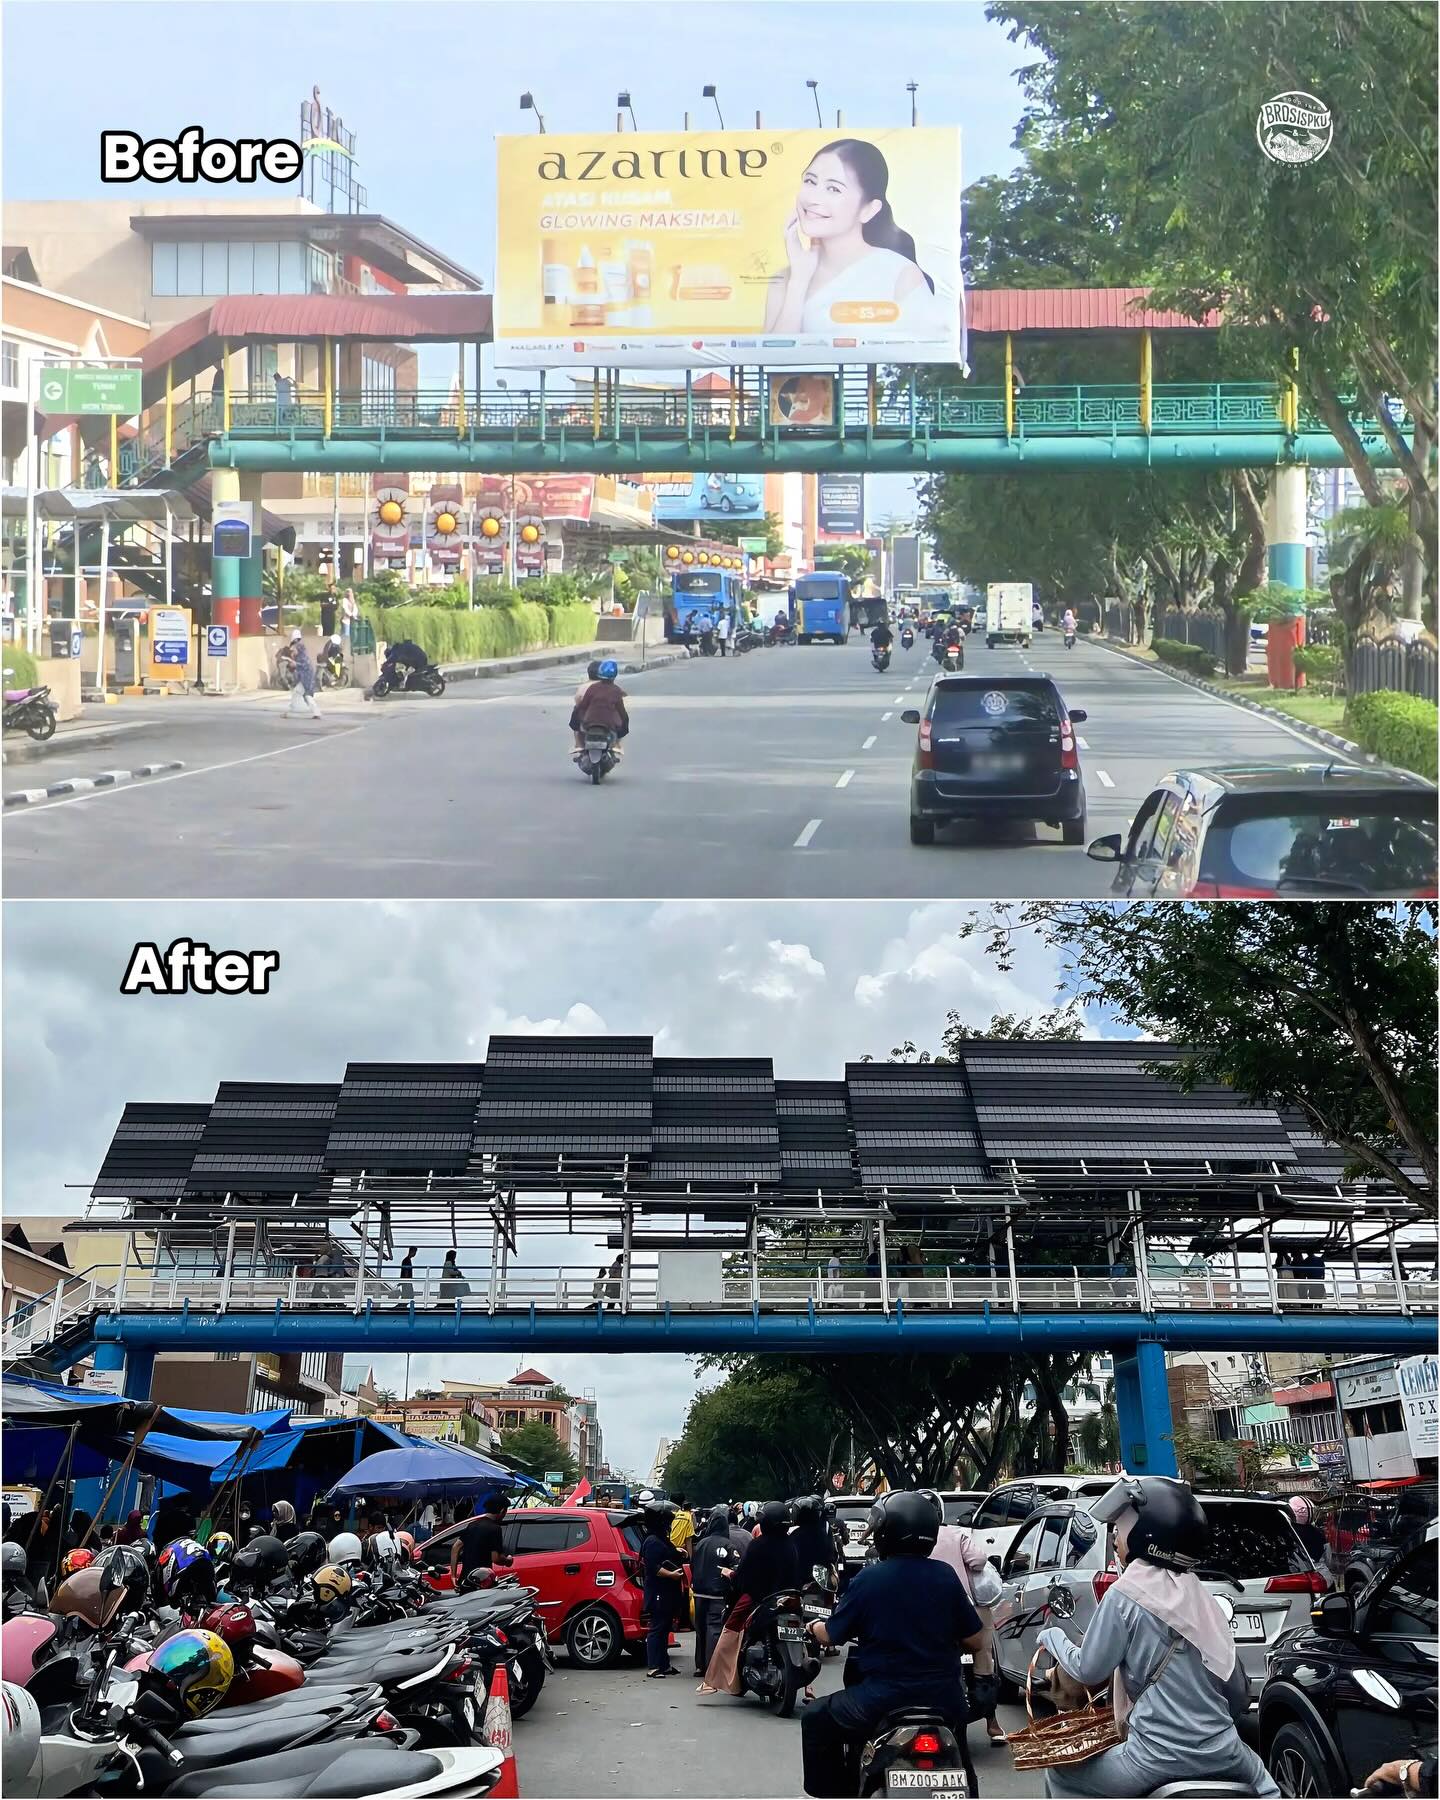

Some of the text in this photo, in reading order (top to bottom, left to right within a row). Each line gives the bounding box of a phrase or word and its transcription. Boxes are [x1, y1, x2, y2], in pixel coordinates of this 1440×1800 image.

[540, 212, 742, 230] GLOWING MAKSIMAL
[1246, 1615, 1260, 1629] TD
[892, 1773, 963, 1787] BM 2005 AAK
